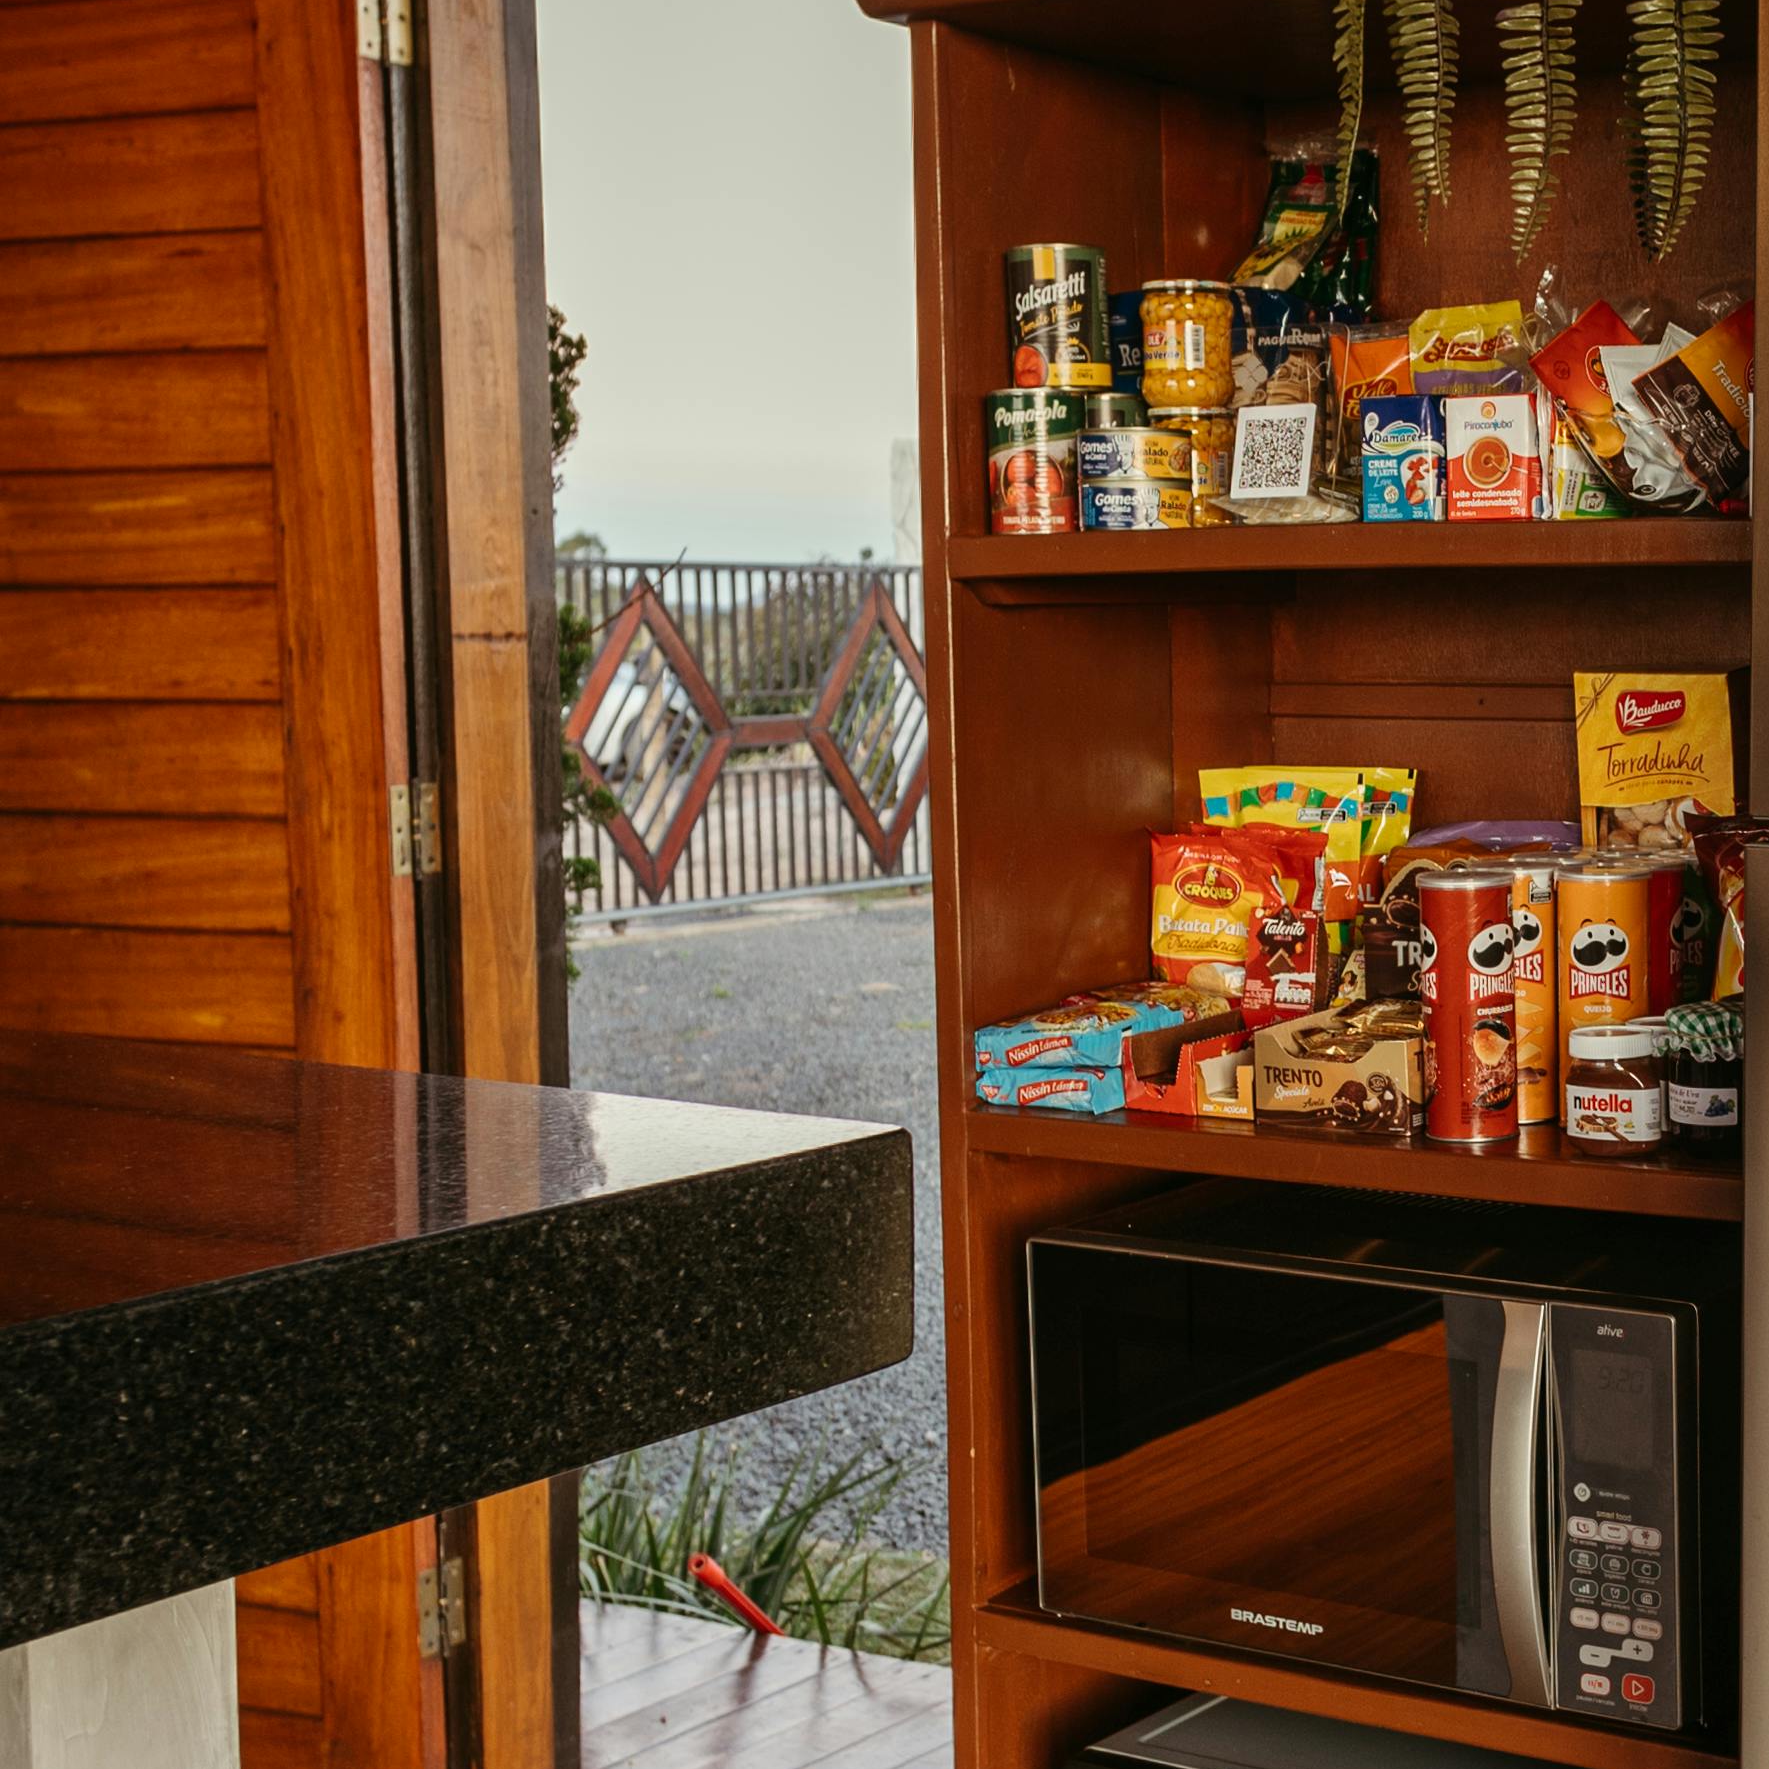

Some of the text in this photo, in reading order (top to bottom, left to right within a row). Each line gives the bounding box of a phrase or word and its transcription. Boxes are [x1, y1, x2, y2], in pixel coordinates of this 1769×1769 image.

[1016, 271, 1085, 321] Salsaretti
[1118, 344, 1141, 368] Re
[1080, 441, 1113, 454] Gomes
[1143, 447, 1169, 457] alado
[1368, 460, 1398, 469] CREME
[1380, 468, 1398, 476] LEITE
[1095, 493, 1141, 507] Gomes
[1452, 488, 1523, 499] leite condensado
[1456, 498, 1519, 508] semidesnatado
[1618, 694, 1683, 727] Bauducco
[1597, 740, 1705, 780] Torradinha
[1184, 882, 1235, 901] CROQUES
[1158, 914, 1210, 934] Batata
[1262, 918, 1306, 936] Talento
[1391, 940, 1422, 968] TR
[1570, 968, 1629, 997] PRINGLES
[1583, 1004, 1613, 1014] QUEIJO
[1008, 1043, 1040, 1065] Nissin
[1263, 1065, 1323, 1088] TRENTO
[1019, 1082, 1051, 1101] Nissin
[1573, 1094, 1633, 1113] nutella
[1230, 1607, 1324, 1636] BRASTEMP
